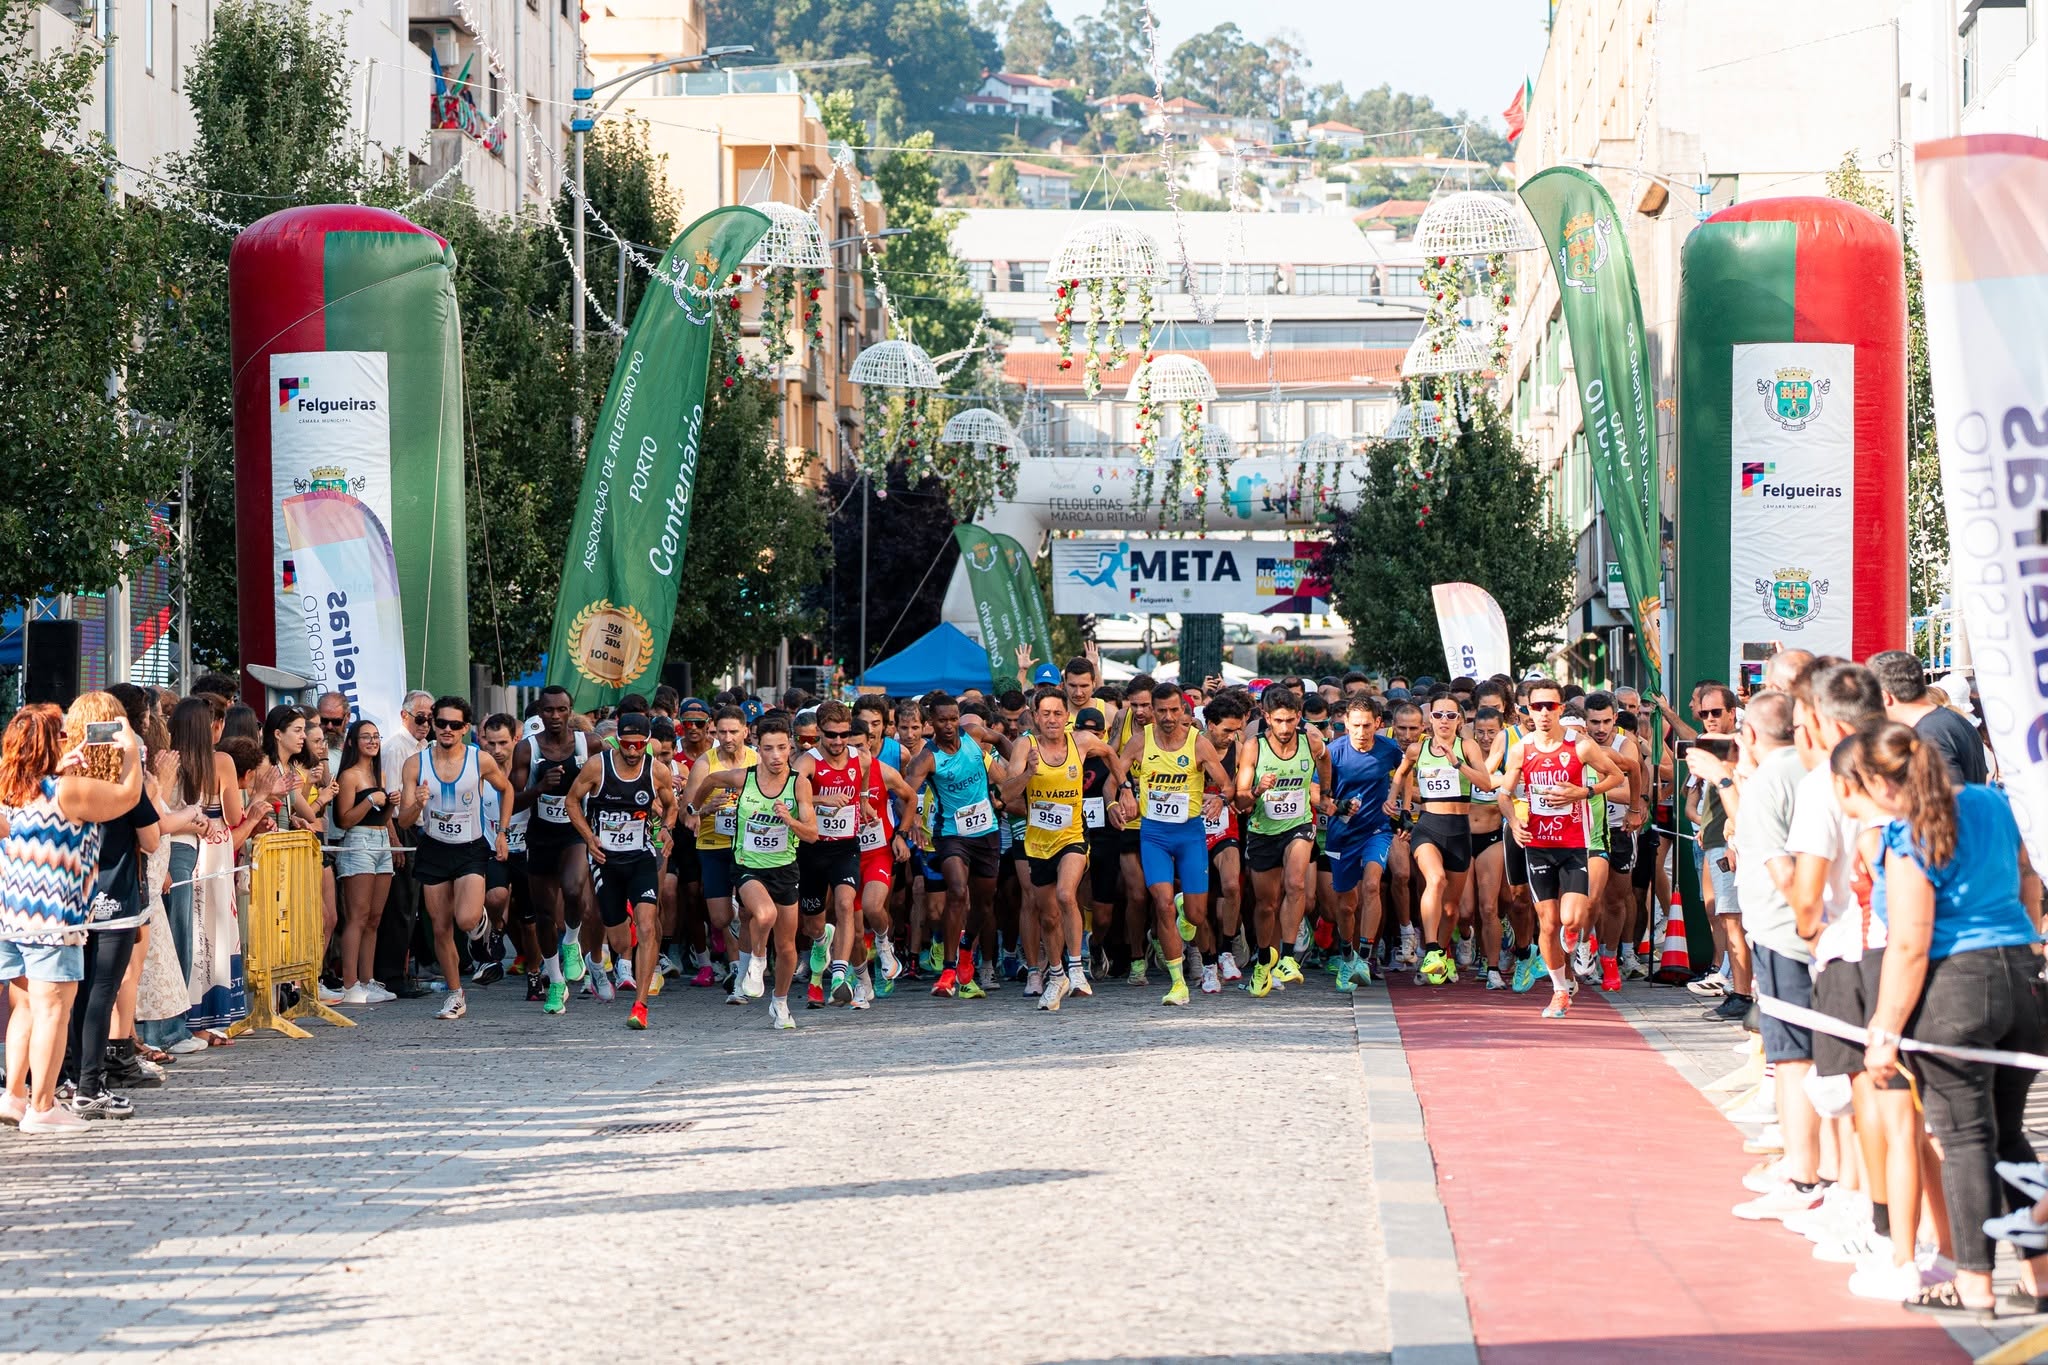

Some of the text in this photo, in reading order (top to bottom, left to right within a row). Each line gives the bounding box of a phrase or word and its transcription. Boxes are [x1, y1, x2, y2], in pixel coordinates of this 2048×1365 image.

[298, 397, 376, 414] Felgueiras
[583, 350, 645, 573] ASSOCIAÇÃO DE ATLETISMO DO
[629, 435, 657, 504] PORTO
[649, 404, 703, 577] Centenário
[1763, 483, 1842, 500] Felgueiras
[1050, 498, 1124, 511] FELGUEIRAS
[1051, 511, 1147, 523] MARCA O RITMO!
[1130, 551, 1241, 581] META
[1258, 580, 1295, 589] FUNDO
[1140, 597, 1174, 605] Felgueiras
[590, 649, 609, 661] 100
[1427, 780, 1451, 791] 653
[1046, 789, 1079, 798] VÁRZEA
[546, 806, 568, 818] 678
[1156, 803, 1179, 815] 970
[1274, 803, 1297, 813] 639
[823, 818, 847, 829] 930
[965, 813, 987, 828] 873
[1039, 811, 1062, 825] 958
[1202, 817, 1220, 827] 54
[438, 821, 462, 834] 853
[610, 832, 634, 843] 784
[754, 836, 779, 847] 655
